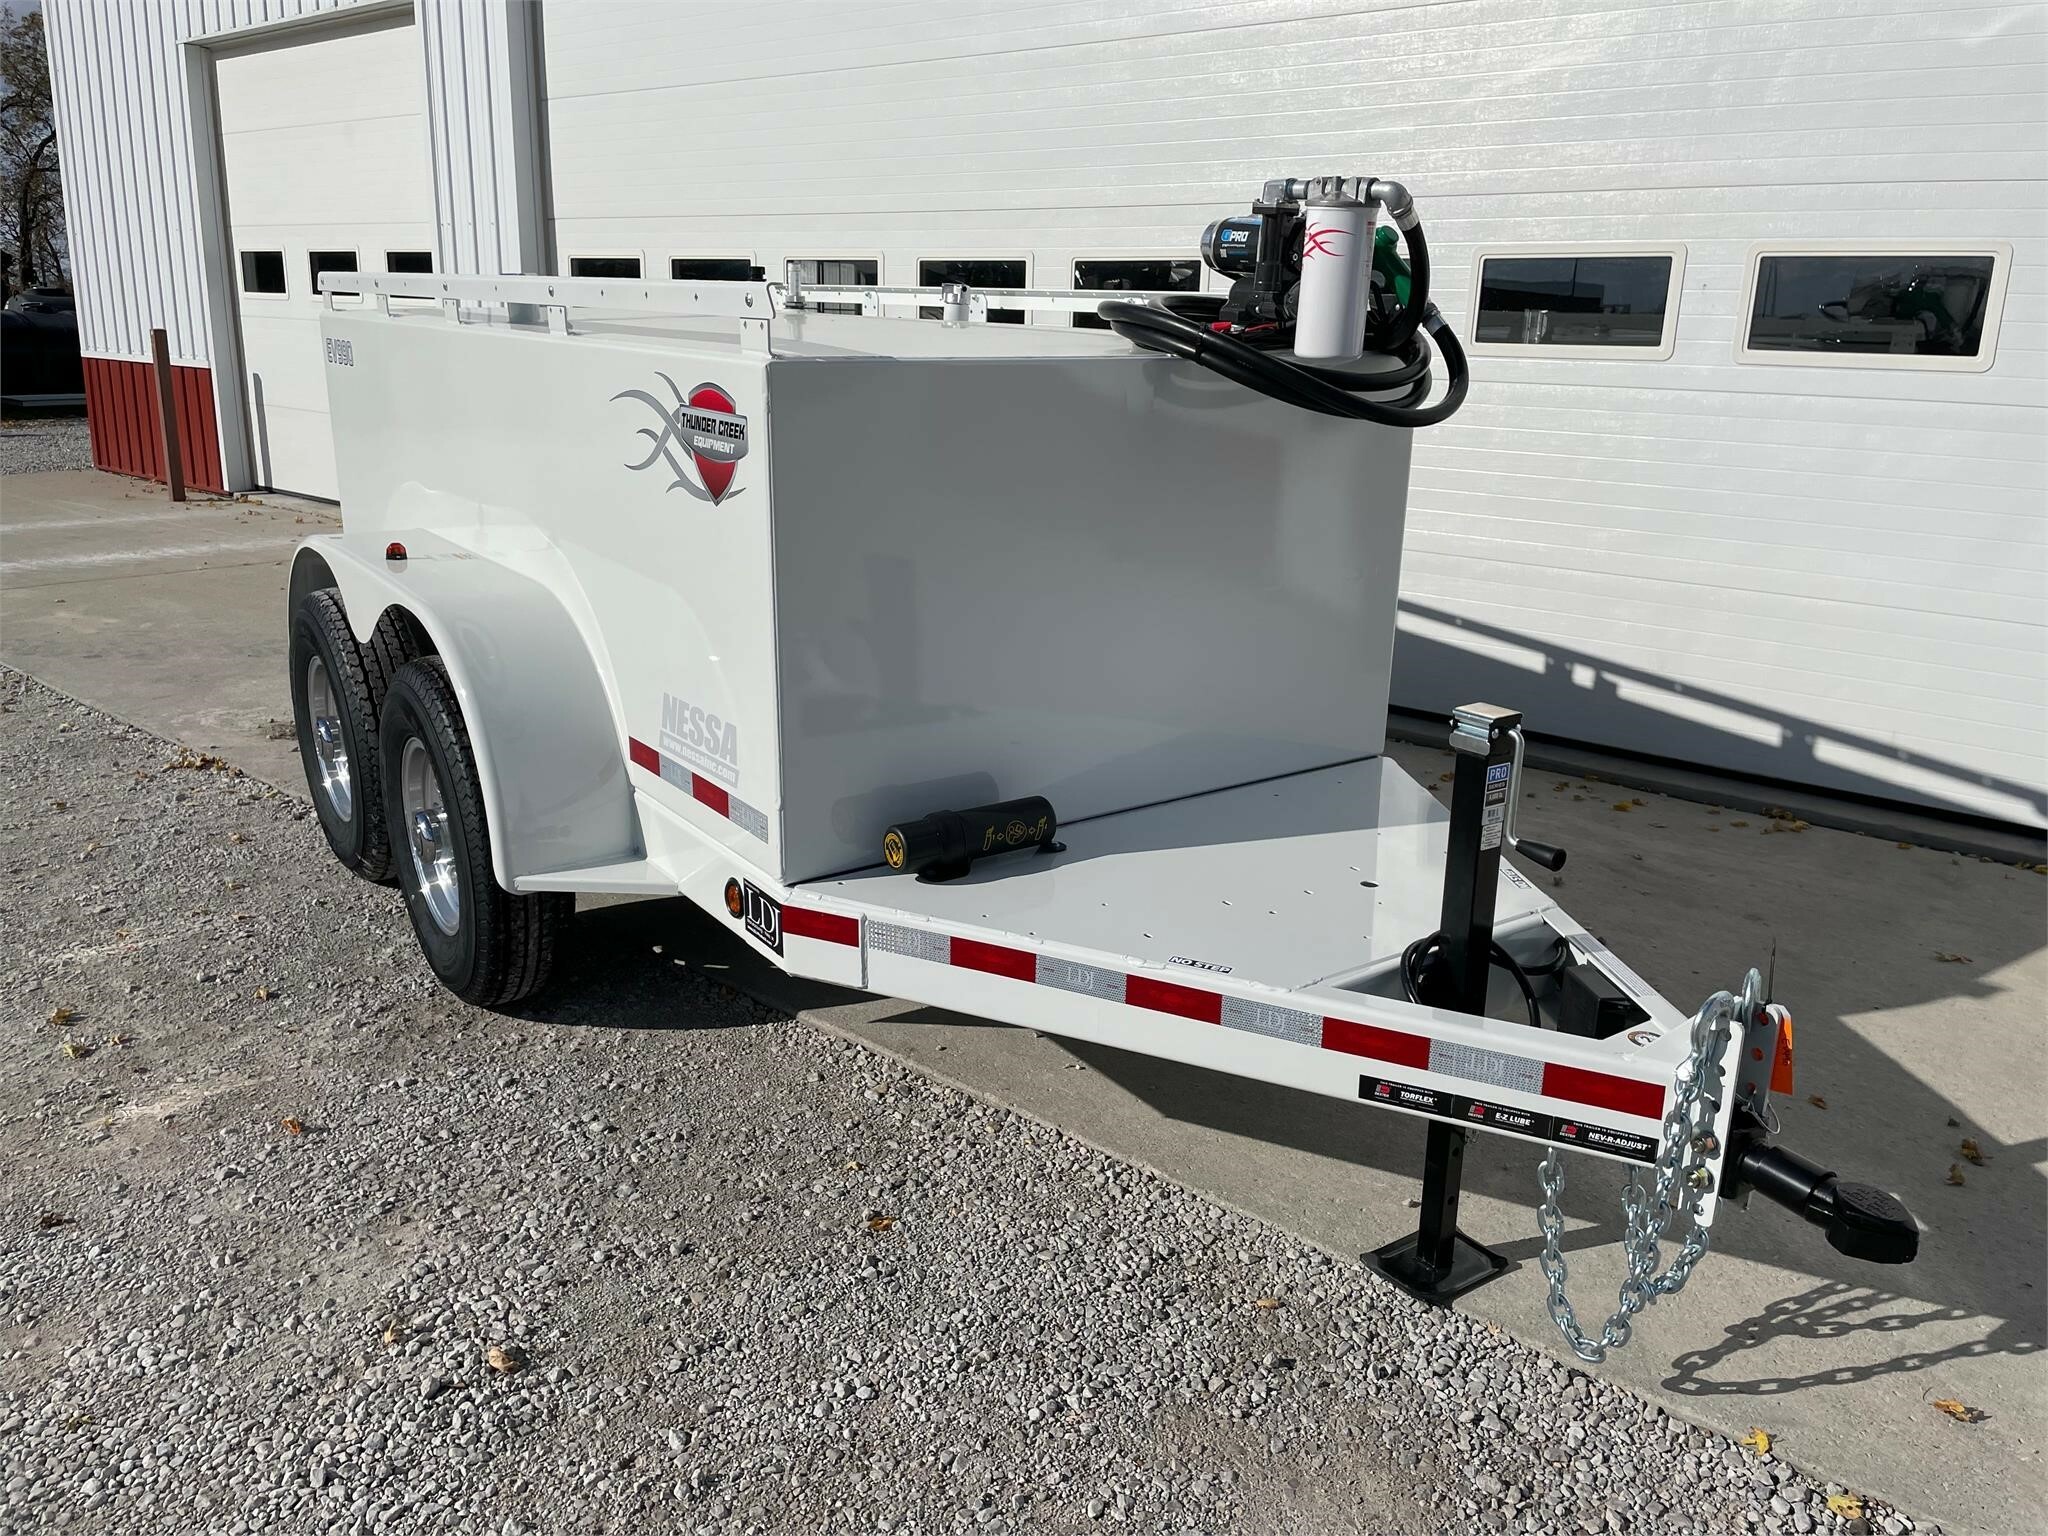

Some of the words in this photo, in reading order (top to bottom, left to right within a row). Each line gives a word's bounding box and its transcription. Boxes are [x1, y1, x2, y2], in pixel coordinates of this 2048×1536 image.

[326, 337, 354, 367] EV990
[681, 412, 717, 435] THUNDER
[718, 419, 746, 441] CREEK
[693, 435, 735, 455] EQUIPMENT
[661, 692, 737, 766] NESSA
[663, 735, 736, 783] www.nessainc.com
[1489, 766, 1507, 781] PRO
[745, 887, 781, 948] LDJ
[1170, 956, 1193, 965] NO
[1194, 961, 1231, 973] STEP
[1400, 1091, 1434, 1104] TORFLEX
[1509, 1115, 1531, 1126] LUBE
